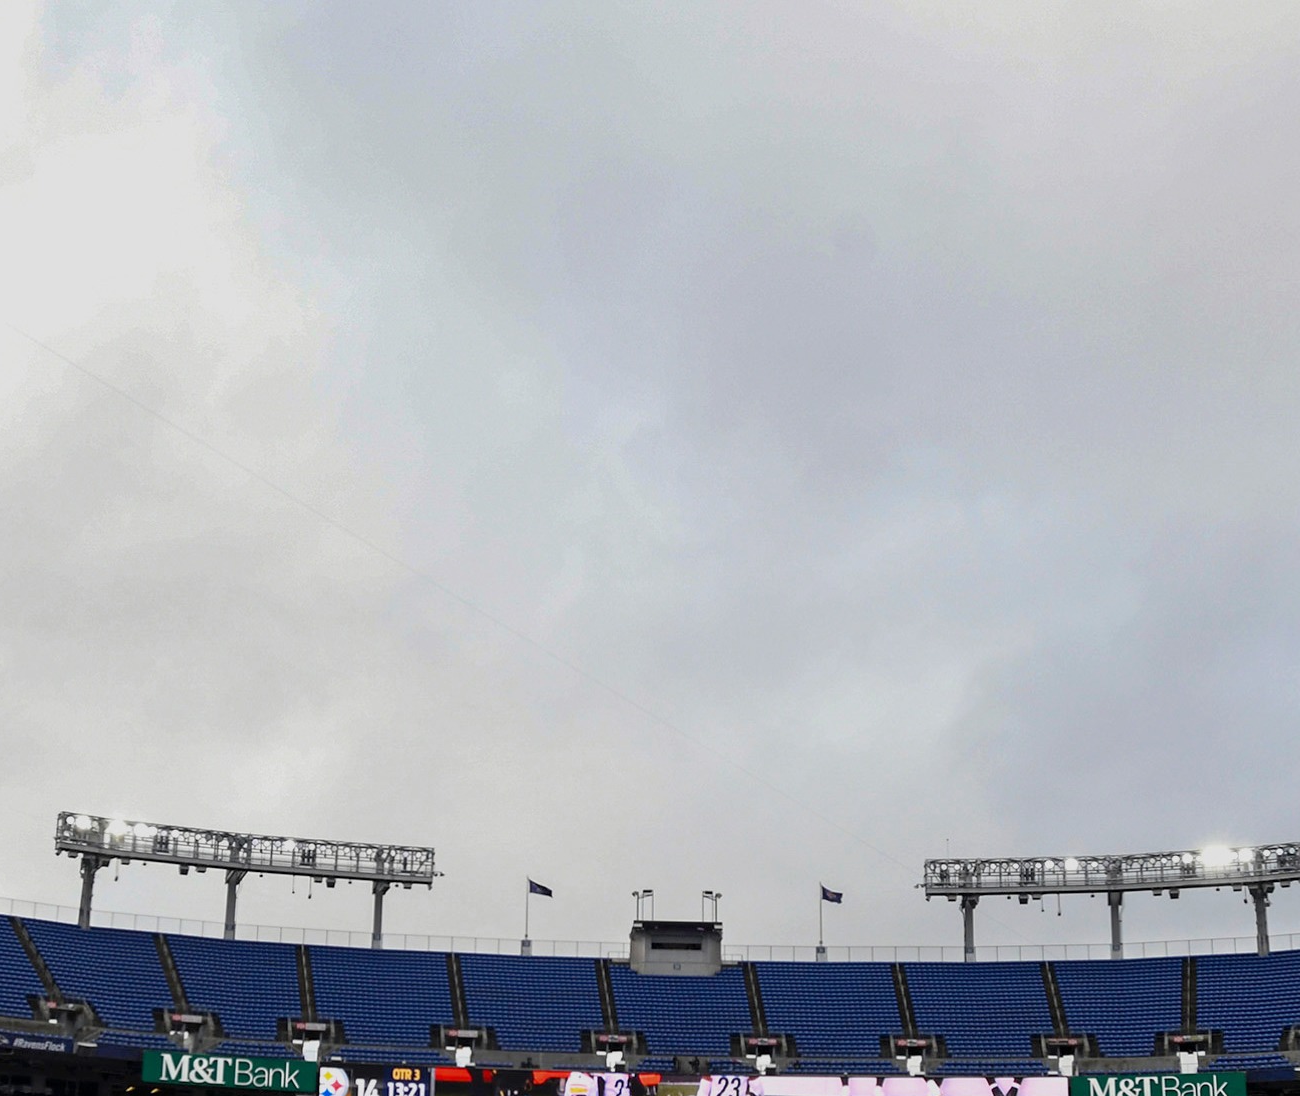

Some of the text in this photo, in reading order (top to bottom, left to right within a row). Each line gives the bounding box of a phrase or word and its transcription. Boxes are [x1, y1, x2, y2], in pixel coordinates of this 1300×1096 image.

[13, 1037, 66, 1052] #RavensFlock
[159, 1052, 300, 1090] M&T Bank
[392, 1067, 412, 1081] QTR
[413, 1068, 421, 1081] 3
